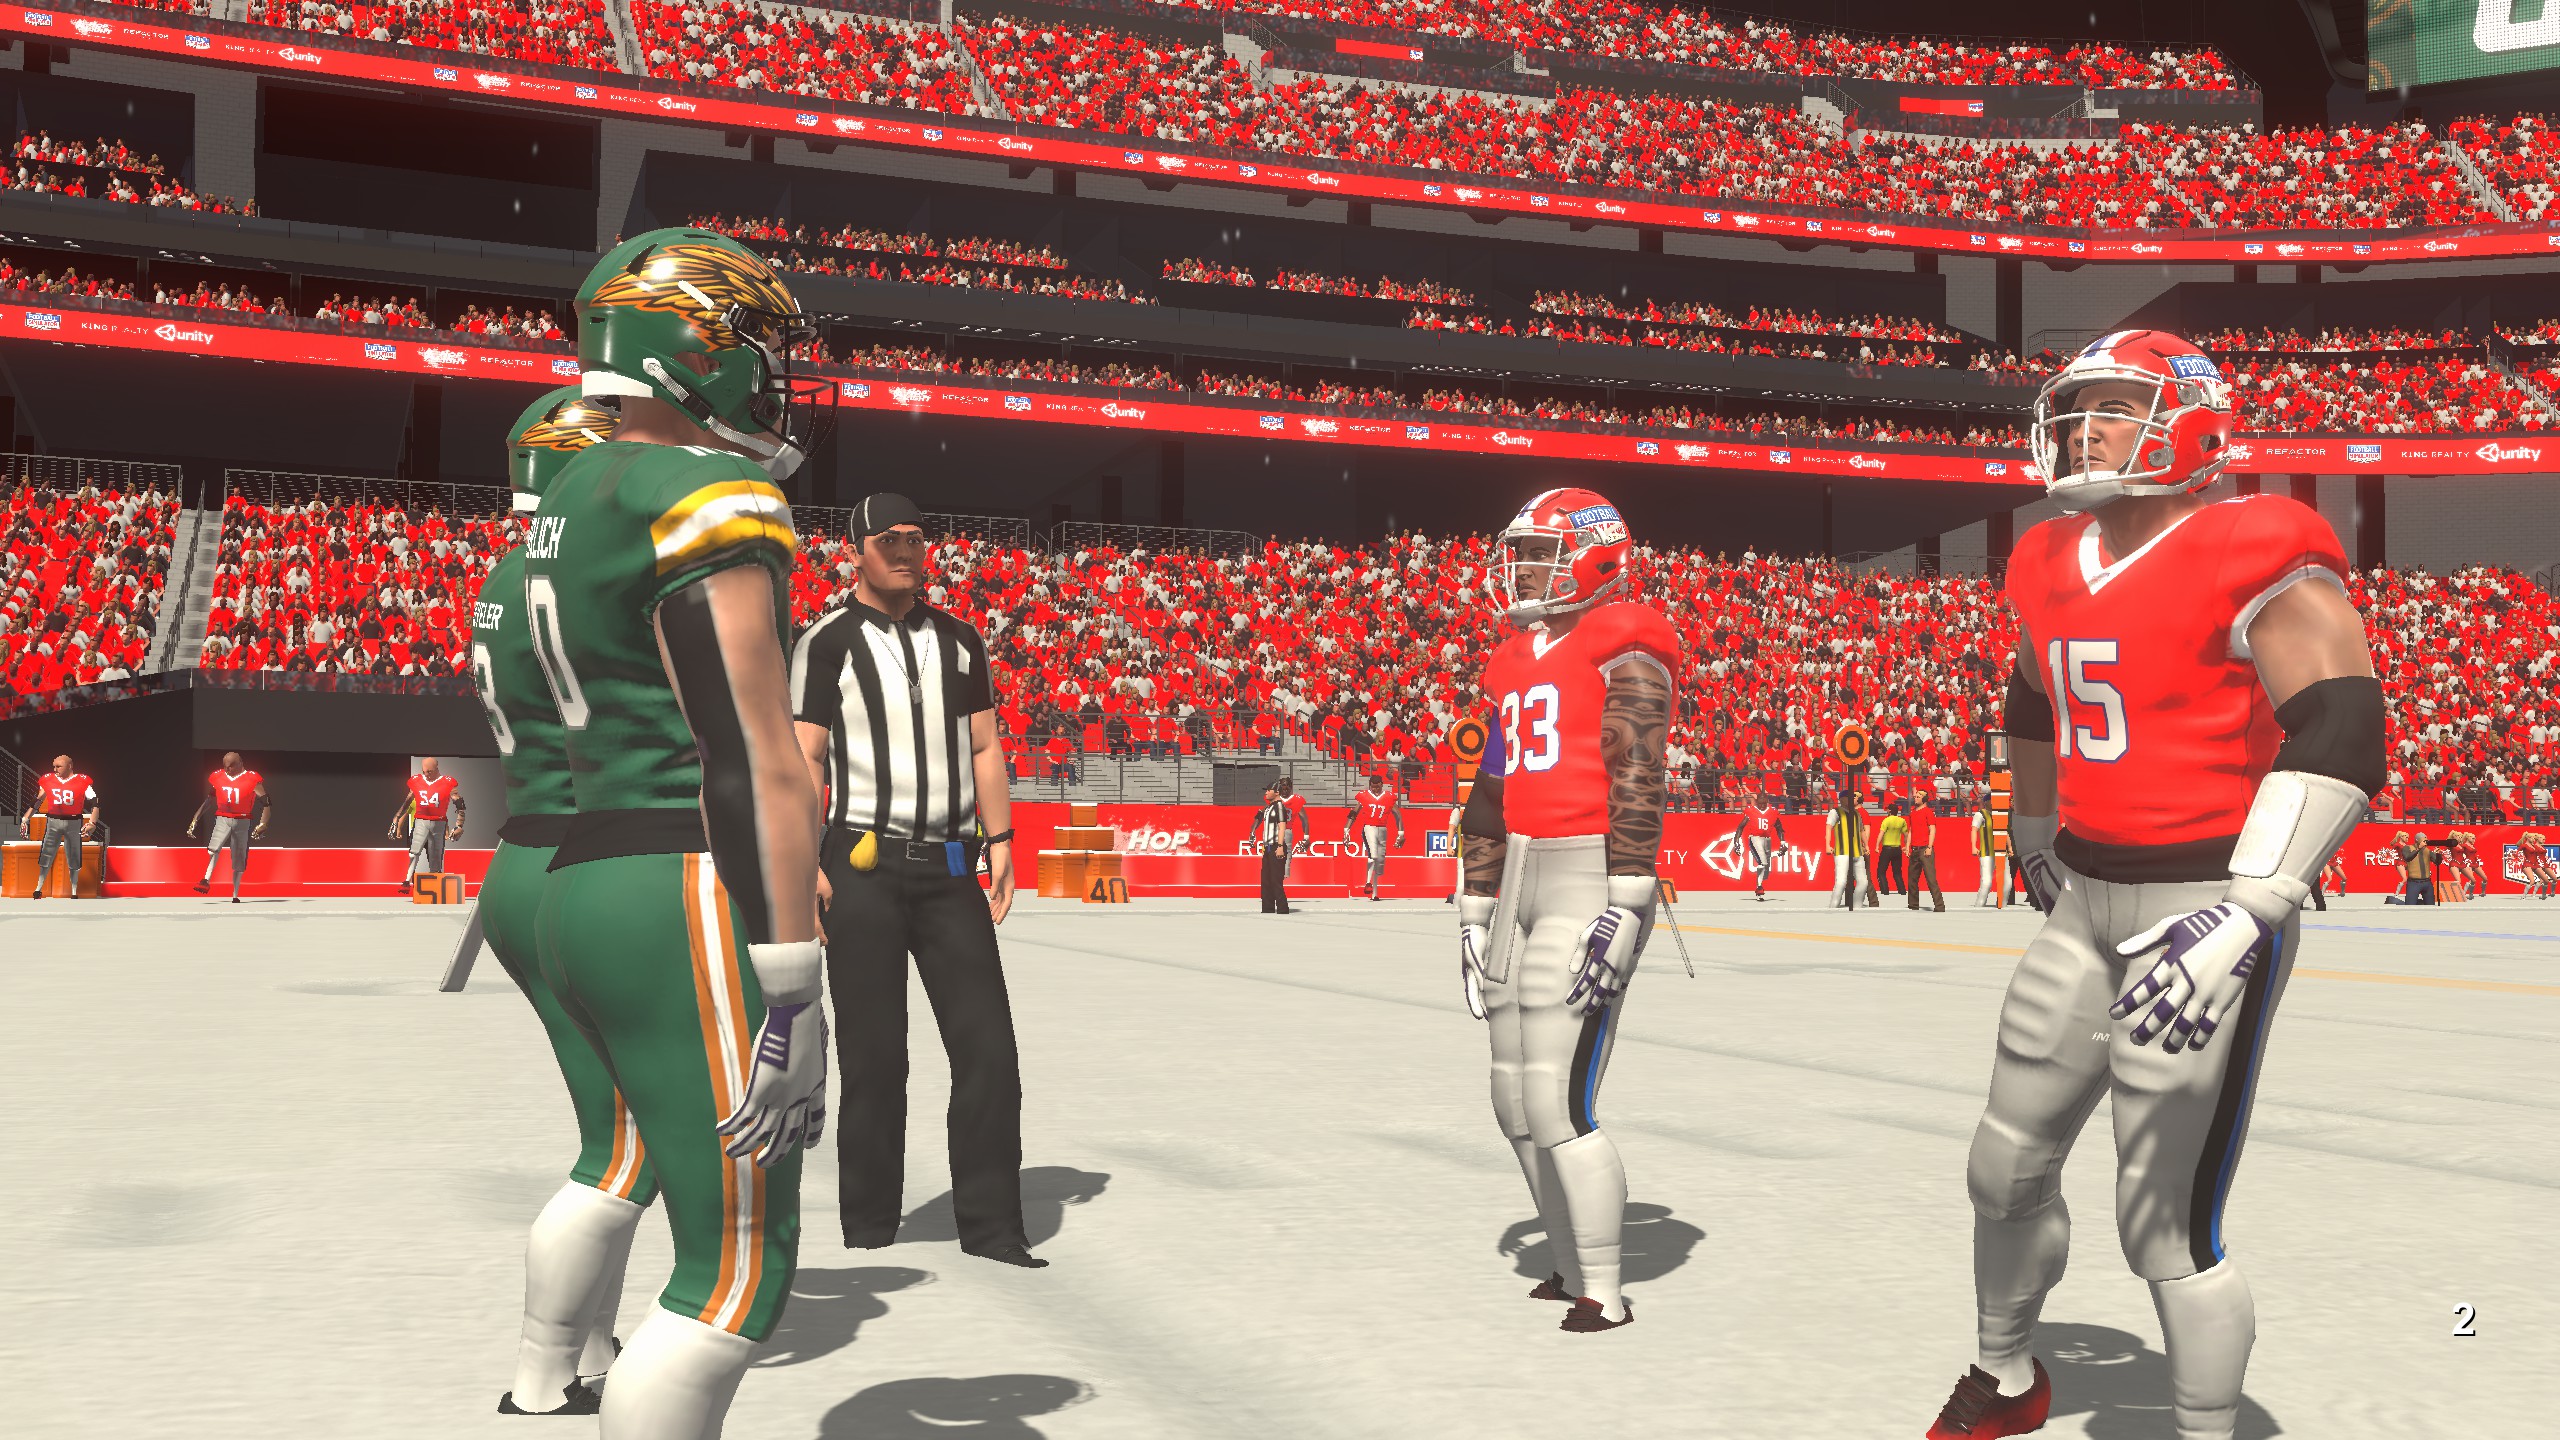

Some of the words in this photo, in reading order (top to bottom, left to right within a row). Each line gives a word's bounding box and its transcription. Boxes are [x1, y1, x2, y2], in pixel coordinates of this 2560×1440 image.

[294, 51, 322, 65] unity
[672, 101, 697, 113] unity
[1011, 141, 1034, 152] unity
[1319, 176, 1340, 187] unity
[1607, 204, 1626, 215] unity
[1877, 228, 1896, 239] unity
[2142, 245, 2163, 254] unity
[2437, 241, 2459, 251] unity
[177, 329, 214, 345] unity
[1118, 407, 1146, 421] unity
[1508, 435, 1533, 448] unity
[2265, 447, 2328, 456] REFACTOR
[2501, 445, 2542, 462] unity
[1863, 458, 1887, 471] unity
[526, 574, 592, 731] 0
[472, 641, 517, 756] 3
[2048, 638, 2130, 764] 15
[1501, 682, 1561, 776] 33
[51, 788, 75, 806] 58
[221, 786, 241, 805] 71
[418, 790, 440, 808] 54
[1368, 803, 1386, 819] 77
[1757, 817, 1769, 831] 16
[1127, 830, 1191, 852] HOP
[416, 874, 463, 905] 50
[1089, 877, 1129, 904] 40
